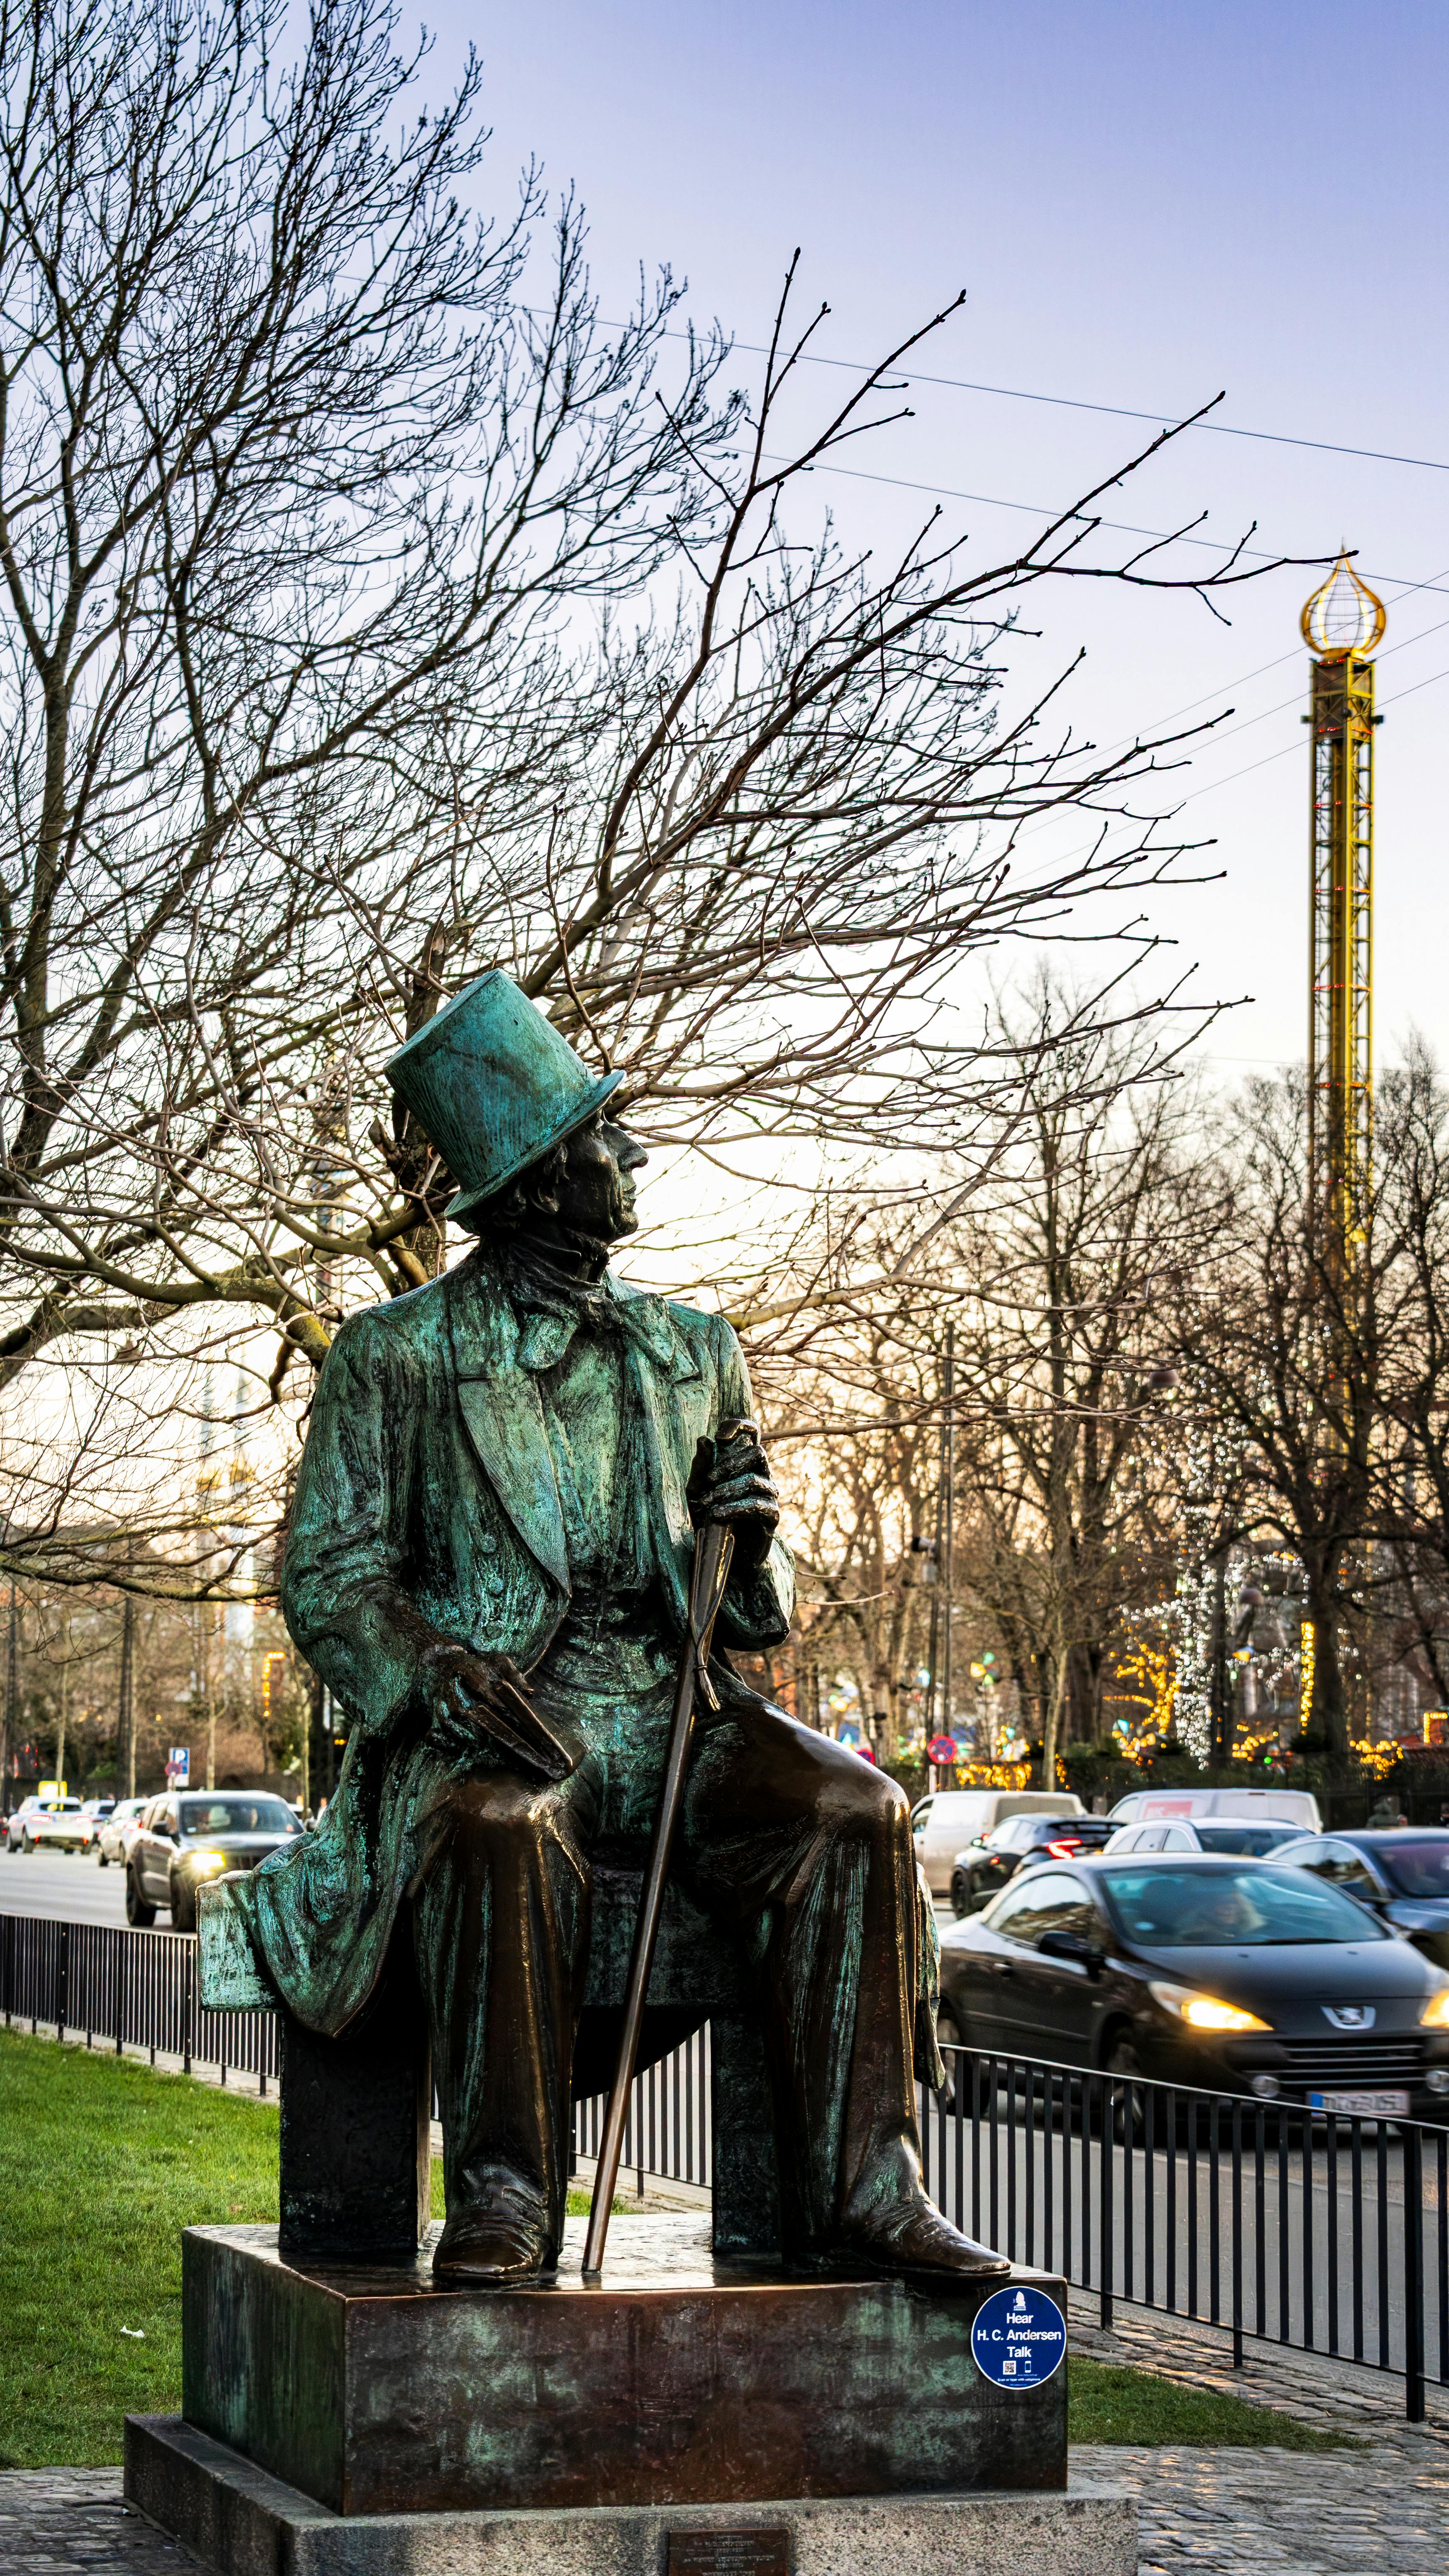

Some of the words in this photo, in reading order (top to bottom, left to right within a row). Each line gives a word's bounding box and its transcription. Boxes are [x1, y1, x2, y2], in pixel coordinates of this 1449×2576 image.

[175, 1749, 186, 1764] P
[1006, 2312, 1034, 2324] Hear
[977, 2330, 989, 2341] H.
[991, 2329, 1004, 2341] C.
[1006, 2329, 1061, 2340] Andersen
[1007, 2346, 1032, 2358] Talk
